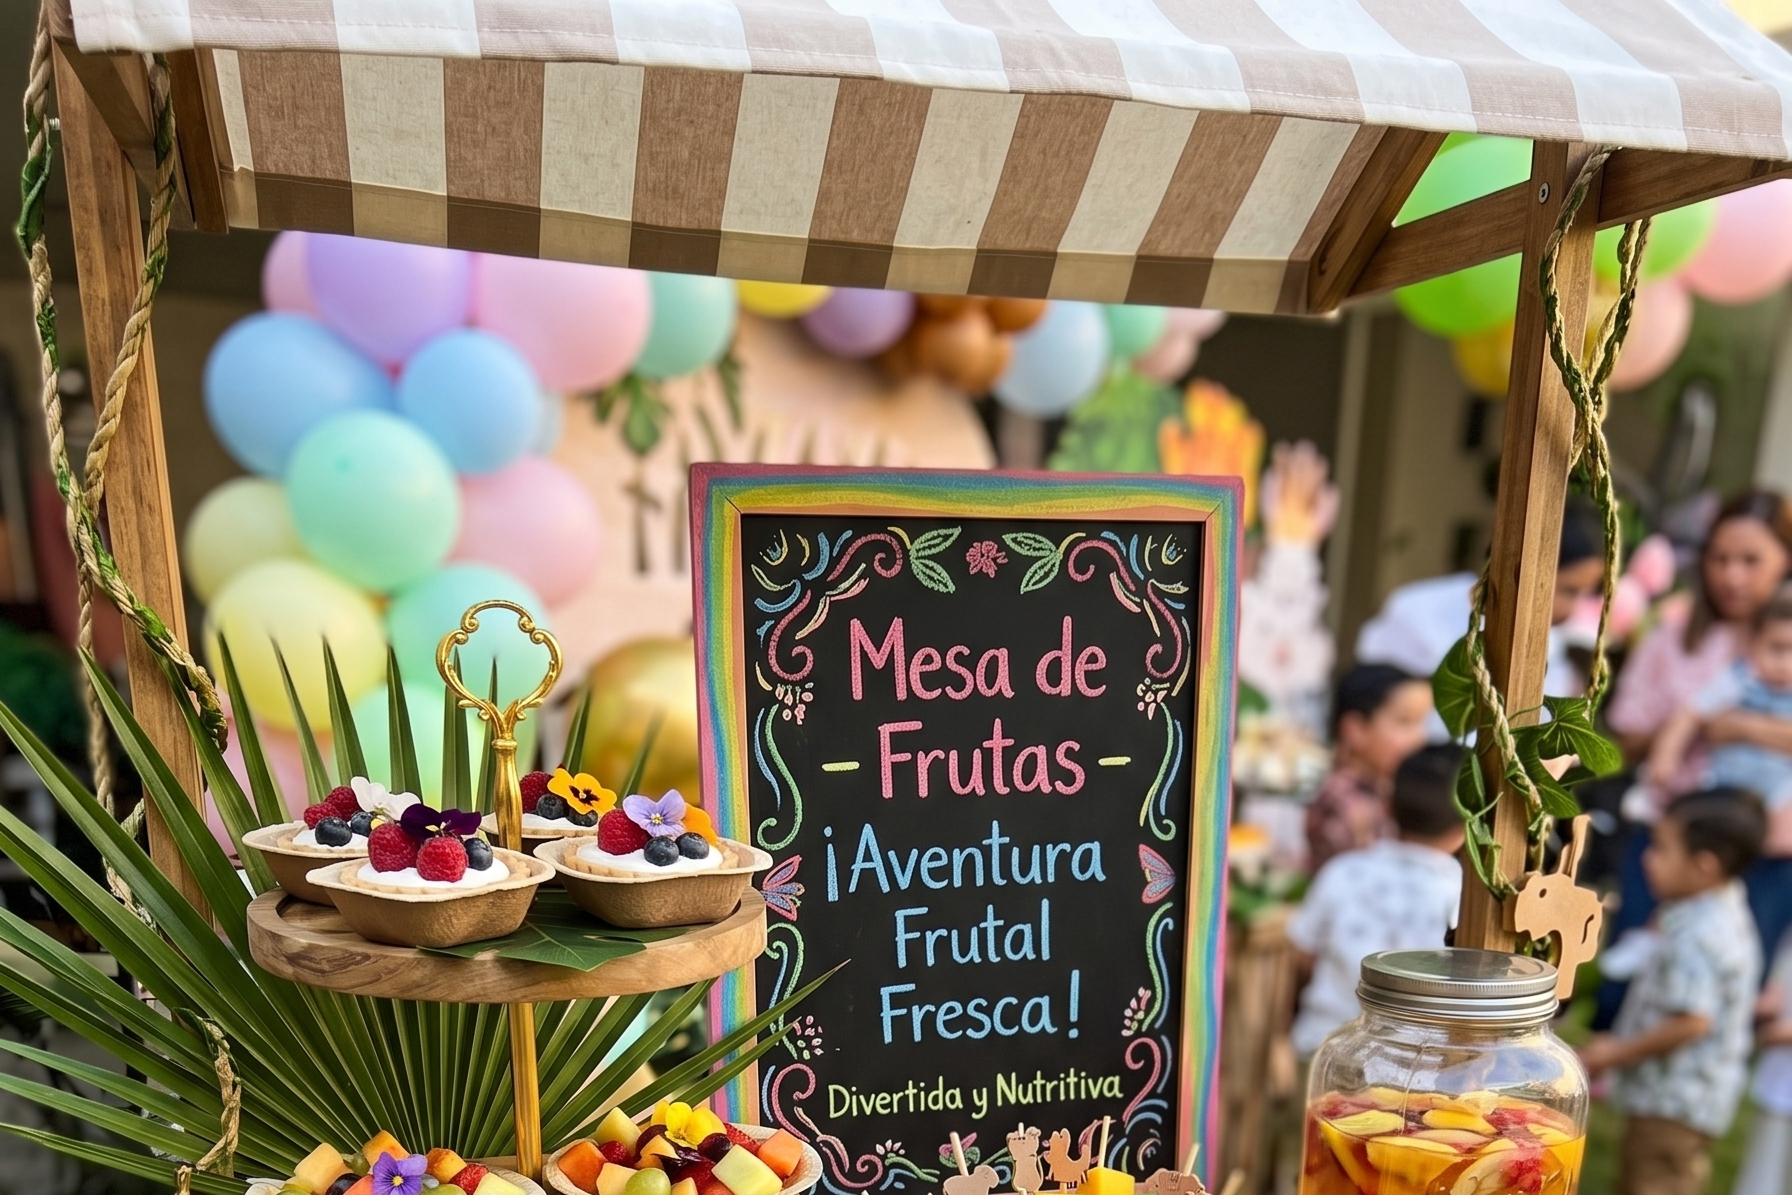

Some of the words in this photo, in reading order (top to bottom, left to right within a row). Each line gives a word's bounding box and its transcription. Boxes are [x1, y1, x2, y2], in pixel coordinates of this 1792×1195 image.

[850, 617, 1014, 701] Mesa
[1036, 616, 1107, 697] de
[878, 718, 1085, 799] Frutas
[824, 820, 1106, 902] ¡Aventura
[895, 898, 1050, 968] Frutal
[880, 970, 1079, 1044] Fresca!
[828, 1076, 963, 1118] Divertida
[972, 1087, 988, 1119] y
[996, 1068, 1124, 1107] Nutritiva
